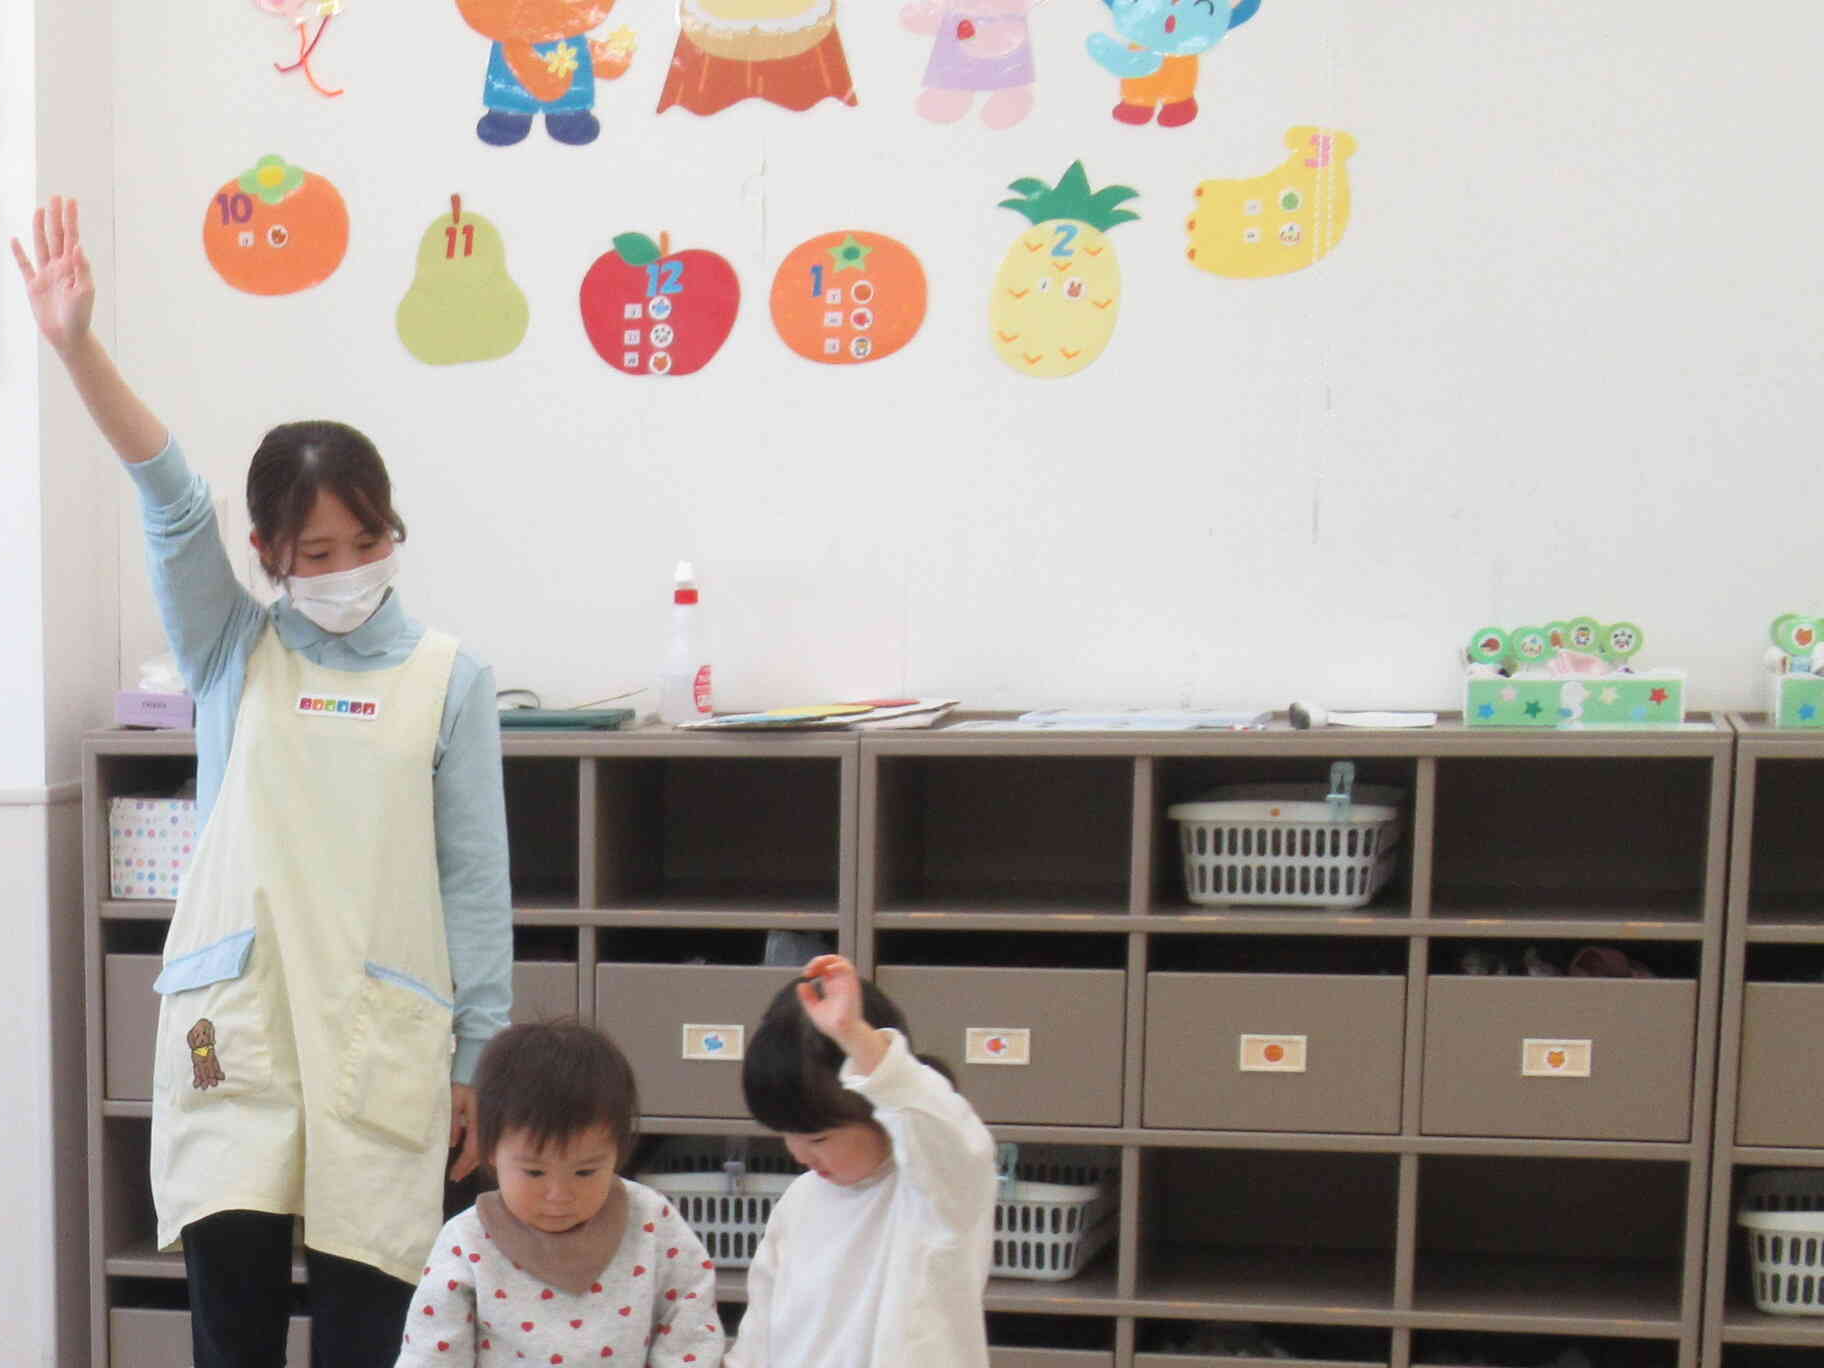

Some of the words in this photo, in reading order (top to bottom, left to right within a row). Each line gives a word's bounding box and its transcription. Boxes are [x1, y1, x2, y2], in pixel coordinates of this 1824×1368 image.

[217, 193, 253, 225] 10
[445, 225, 475, 260] 11
[1051, 224, 1079, 257] 2
[646, 261, 685, 297] 12
[810, 264, 824, 297] 1
